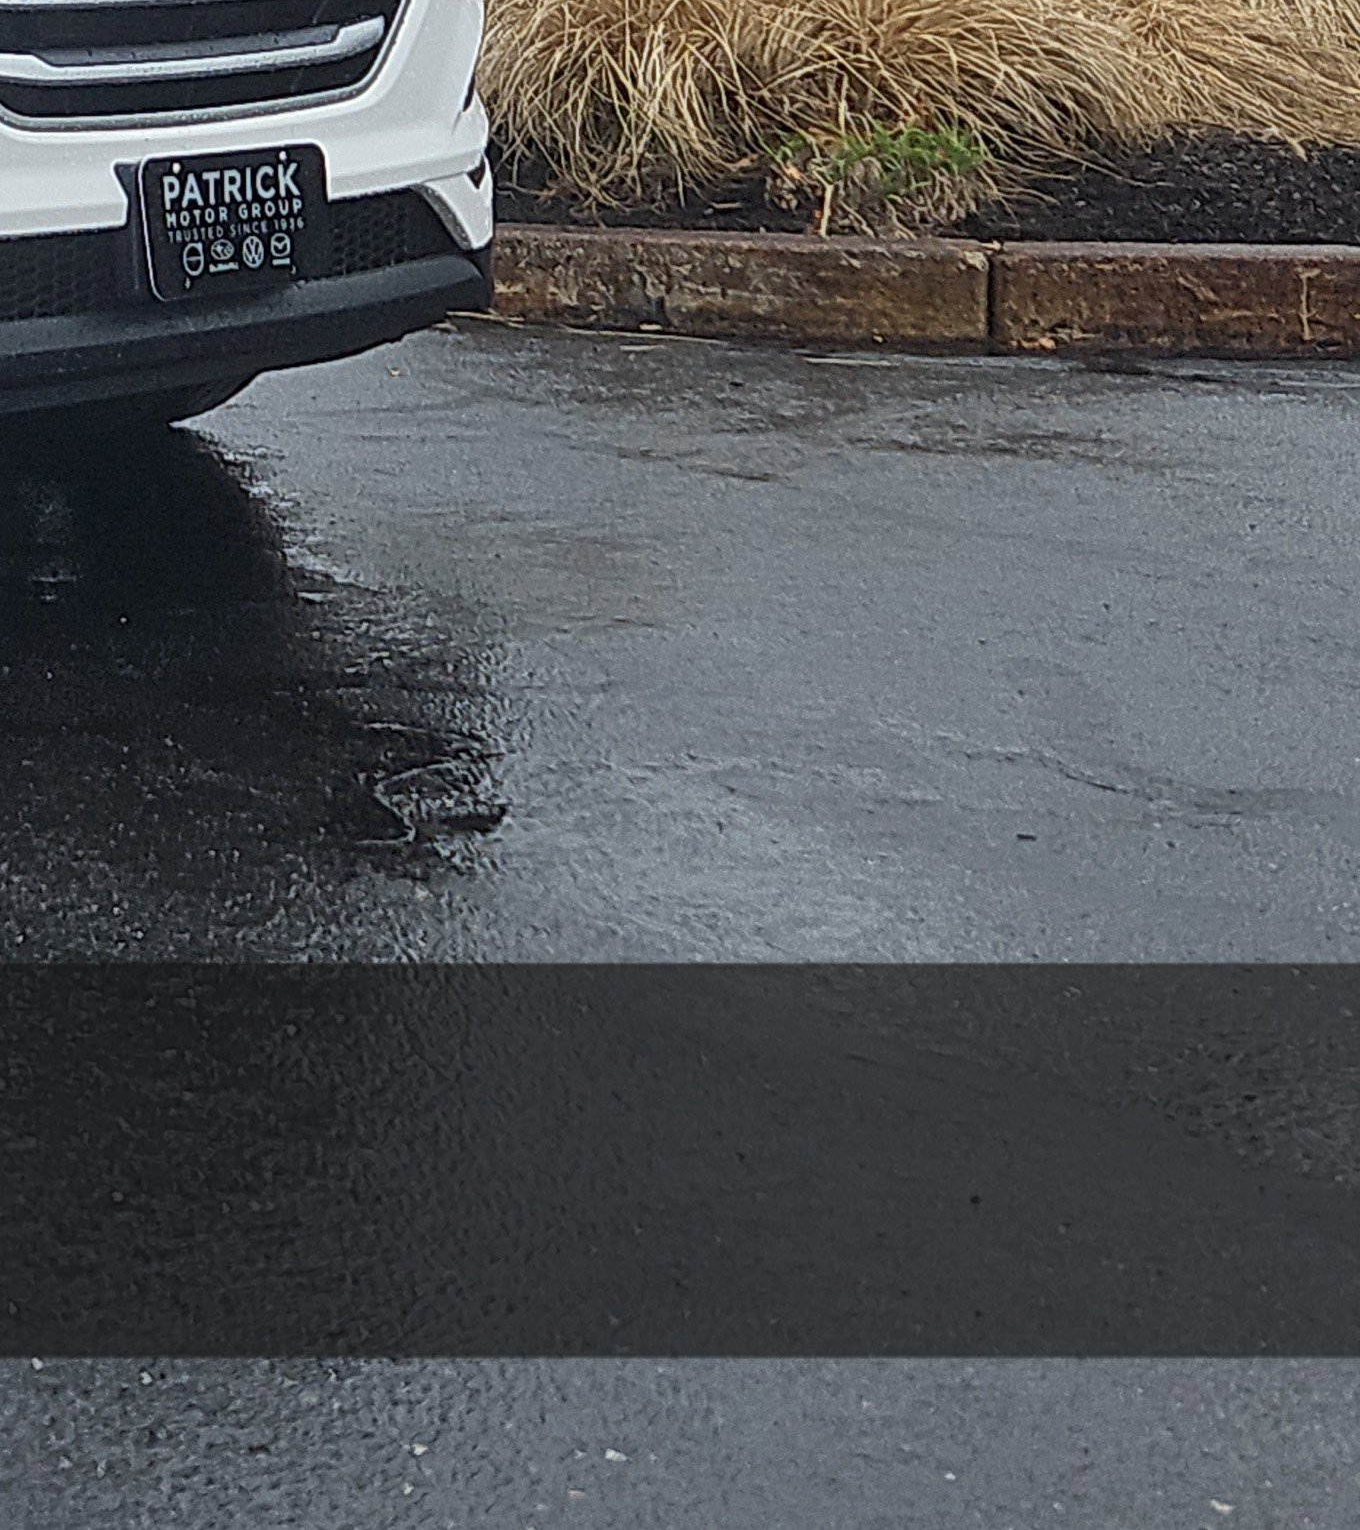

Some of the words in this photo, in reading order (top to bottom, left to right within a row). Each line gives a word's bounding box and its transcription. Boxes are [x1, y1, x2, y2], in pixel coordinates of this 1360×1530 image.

[162, 162, 301, 210] PATRICK
[166, 206, 228, 228] MOTOR
[238, 200, 303, 218] GROUP
[167, 225, 224, 243] TRUSTED
[230, 220, 268, 238] SINCE
